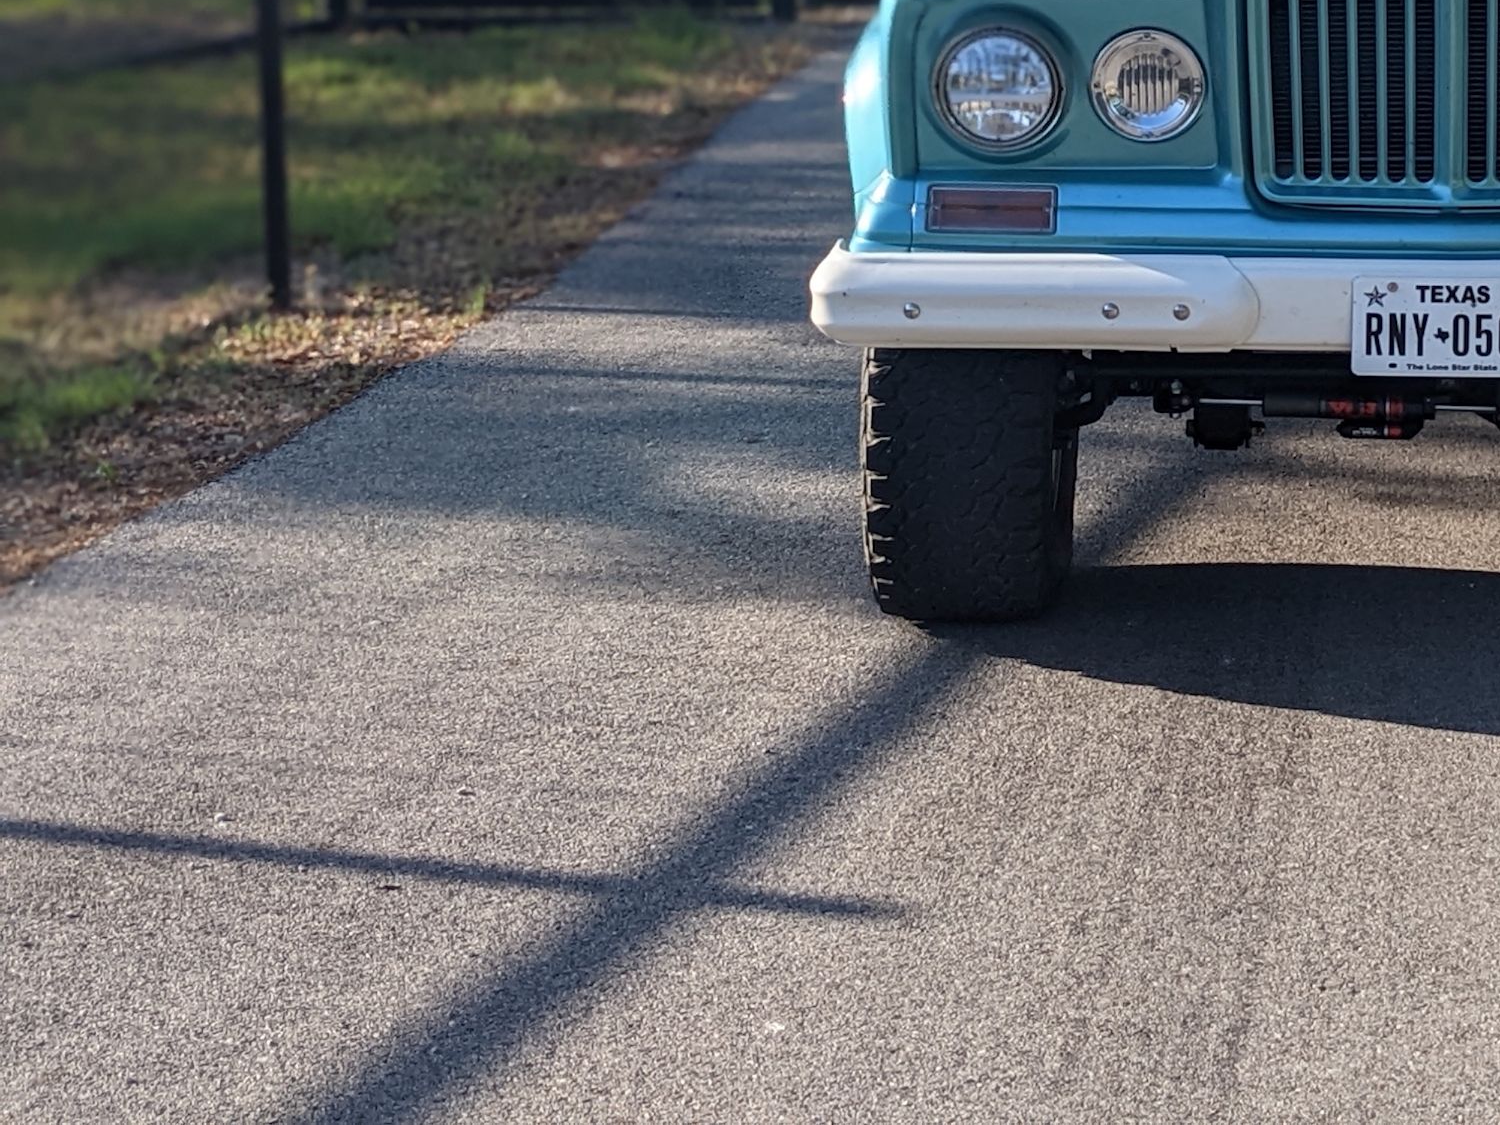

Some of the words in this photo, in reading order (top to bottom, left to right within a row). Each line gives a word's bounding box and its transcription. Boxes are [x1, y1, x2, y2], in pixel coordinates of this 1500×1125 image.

[1416, 285, 1491, 305] TEXAS
[1365, 313, 1430, 357] RNY
[1406, 363, 1424, 371] The
[1426, 363, 1449, 371] Lone
[1452, 364, 1471, 372] Star
[1473, 364, 1498, 372] State
